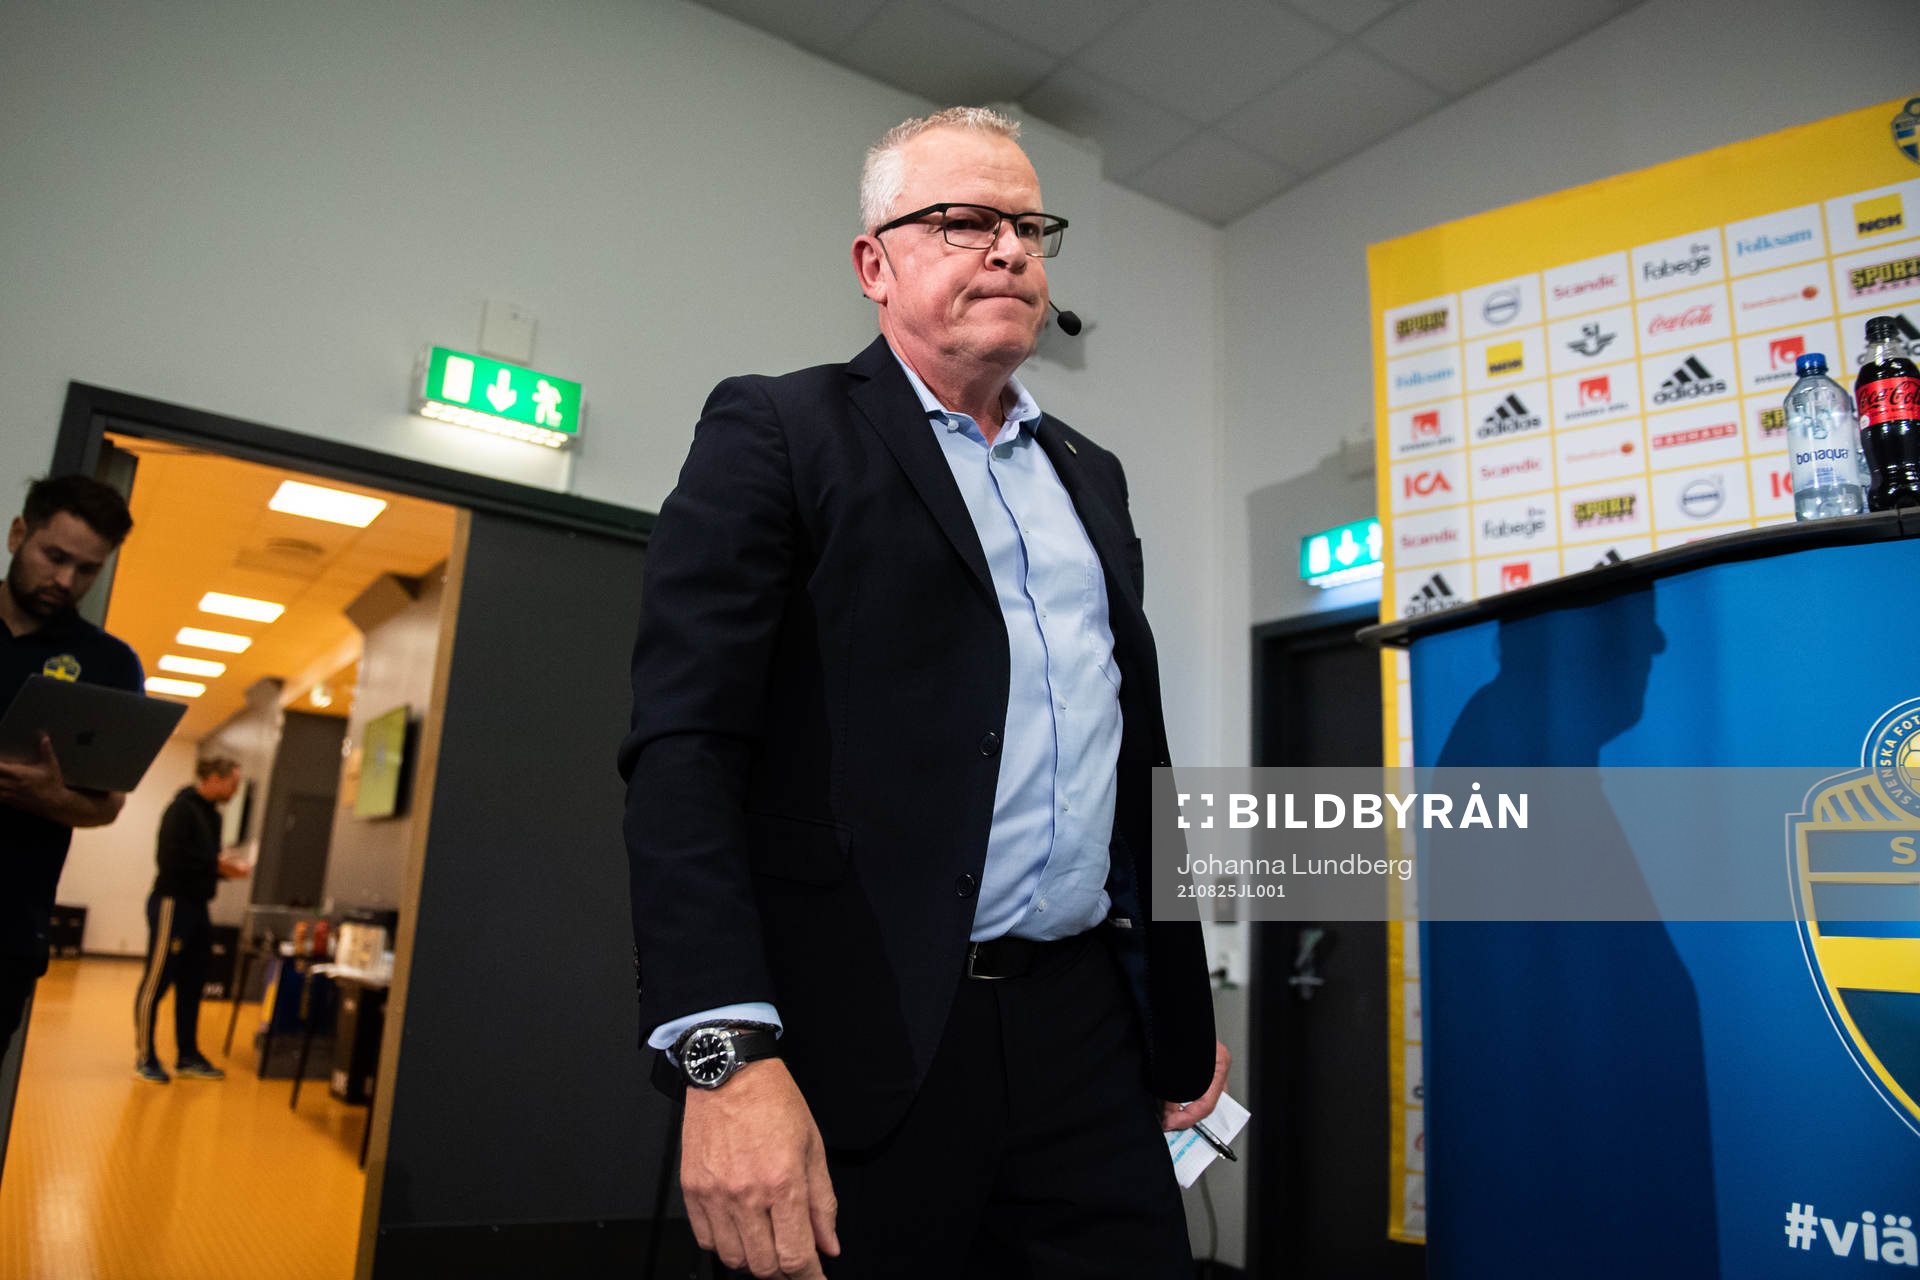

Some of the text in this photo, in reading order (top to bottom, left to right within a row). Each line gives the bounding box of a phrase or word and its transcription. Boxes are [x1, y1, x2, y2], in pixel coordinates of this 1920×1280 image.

[1737, 229, 1812, 256] Folksam
[1644, 254, 1711, 280] Fabege
[1554, 275, 1615, 298] Scandic
[1653, 380, 1727, 405] adidas
[1478, 417, 1541, 439] adidas
[1481, 458, 1541, 479] Scandic
[1796, 448, 1849, 466] bonaqua
[1404, 471, 1451, 498] ICA
[1484, 520, 1545, 539] Fabege
[1880, 738, 1912, 805] SVENSKA
[1784, 1202, 1919, 1267] #viä
